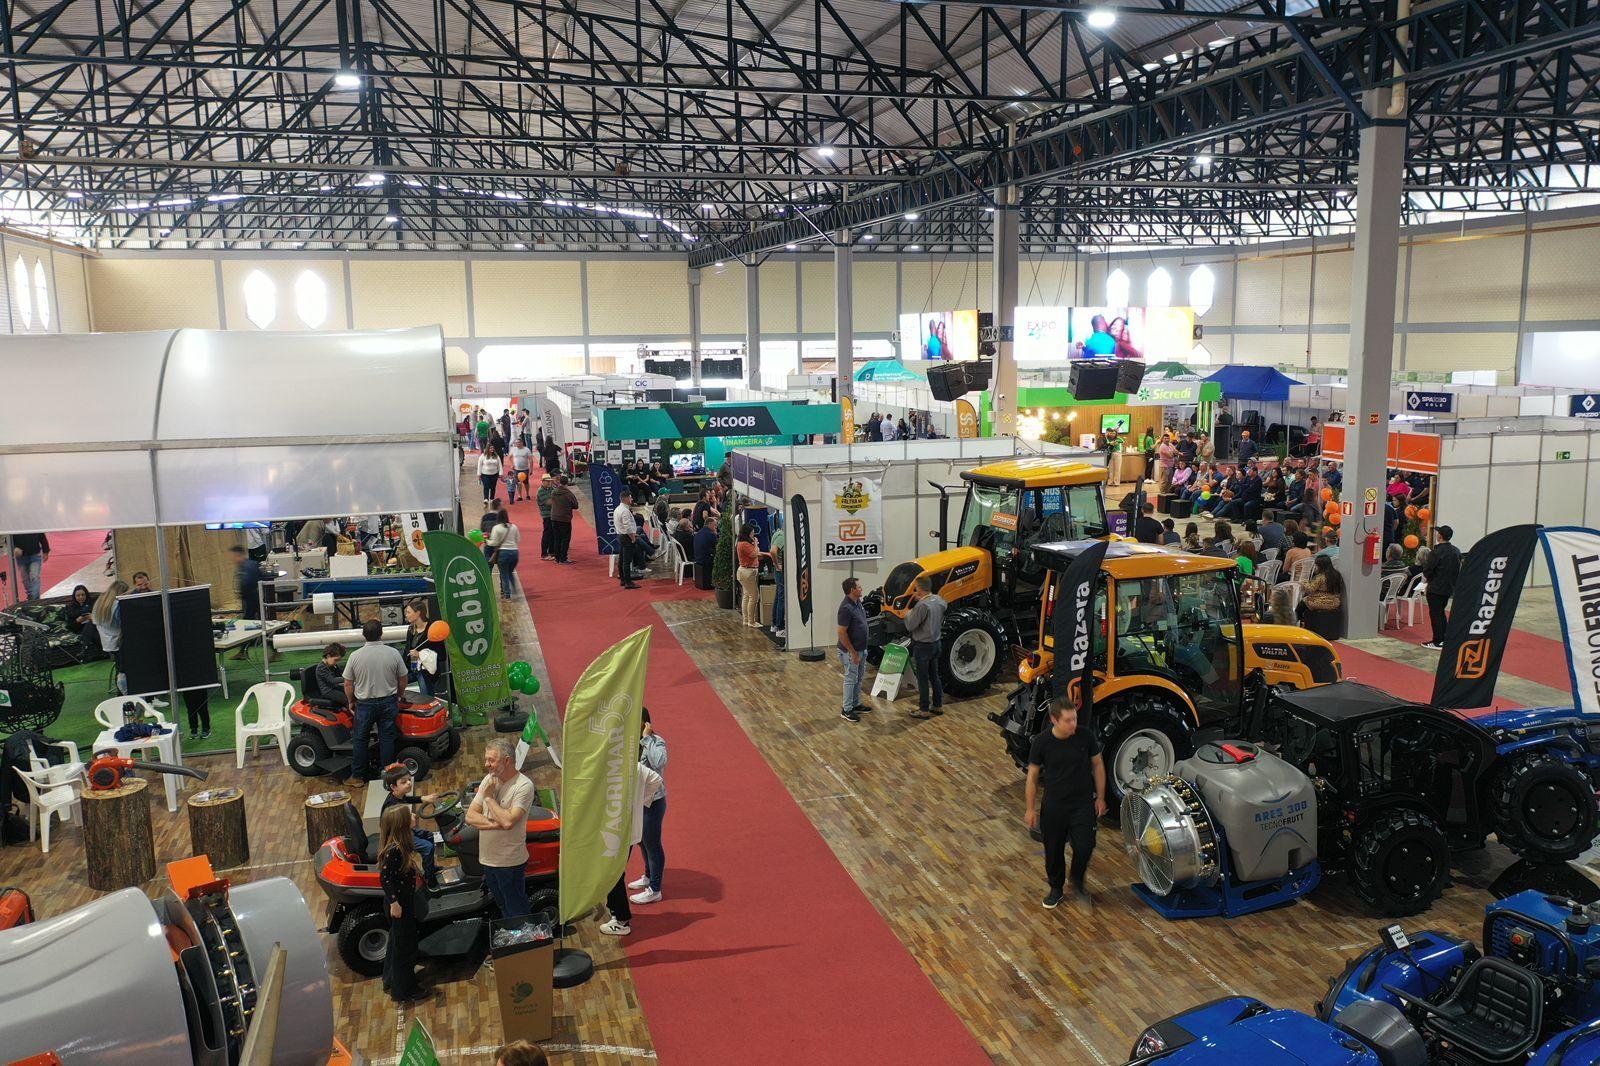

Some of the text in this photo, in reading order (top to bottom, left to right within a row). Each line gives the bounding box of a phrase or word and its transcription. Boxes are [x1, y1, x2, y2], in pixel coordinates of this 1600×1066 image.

[1152, 387, 1192, 400] Sicredi
[709, 416, 756, 428] SICOOB
[602, 486, 616, 535] banrisul
[825, 543, 878, 556] Razera
[449, 569, 488, 657] Sabiá
[1469, 556, 1508, 635] Razera
[1070, 581, 1090, 671] Razera
[589, 692, 633, 832] AGRIMAR 55
[1254, 800, 1307, 822] ARES 300
[1260, 813, 1304, 831] TECNOFRUTT
